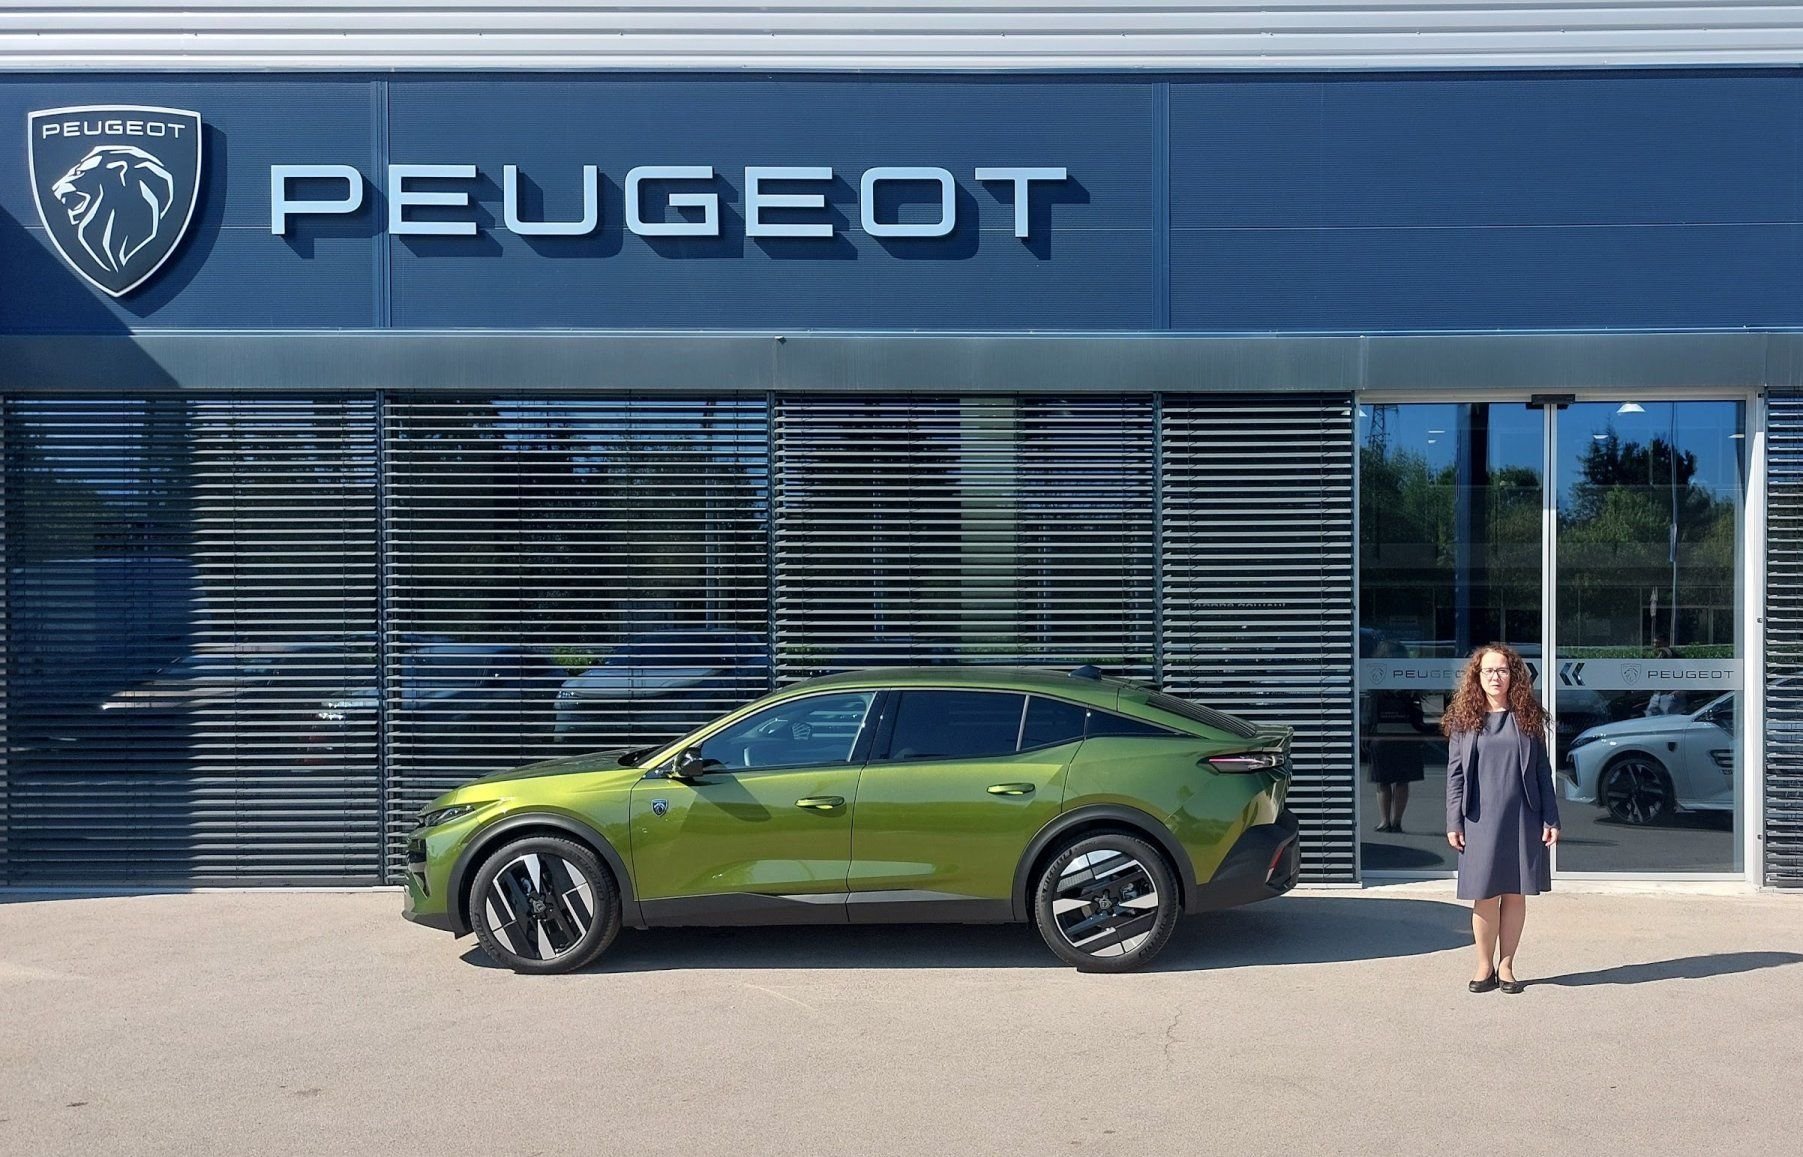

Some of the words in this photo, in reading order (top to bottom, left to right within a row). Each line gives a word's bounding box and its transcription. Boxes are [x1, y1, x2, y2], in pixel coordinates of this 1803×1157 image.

[42, 120, 186, 139] PEUGEOT
[270, 164, 1067, 238] PEUGEOT
[1392, 669, 1466, 679] PEUGEO
[1647, 670, 1735, 679] PEUGEOT
